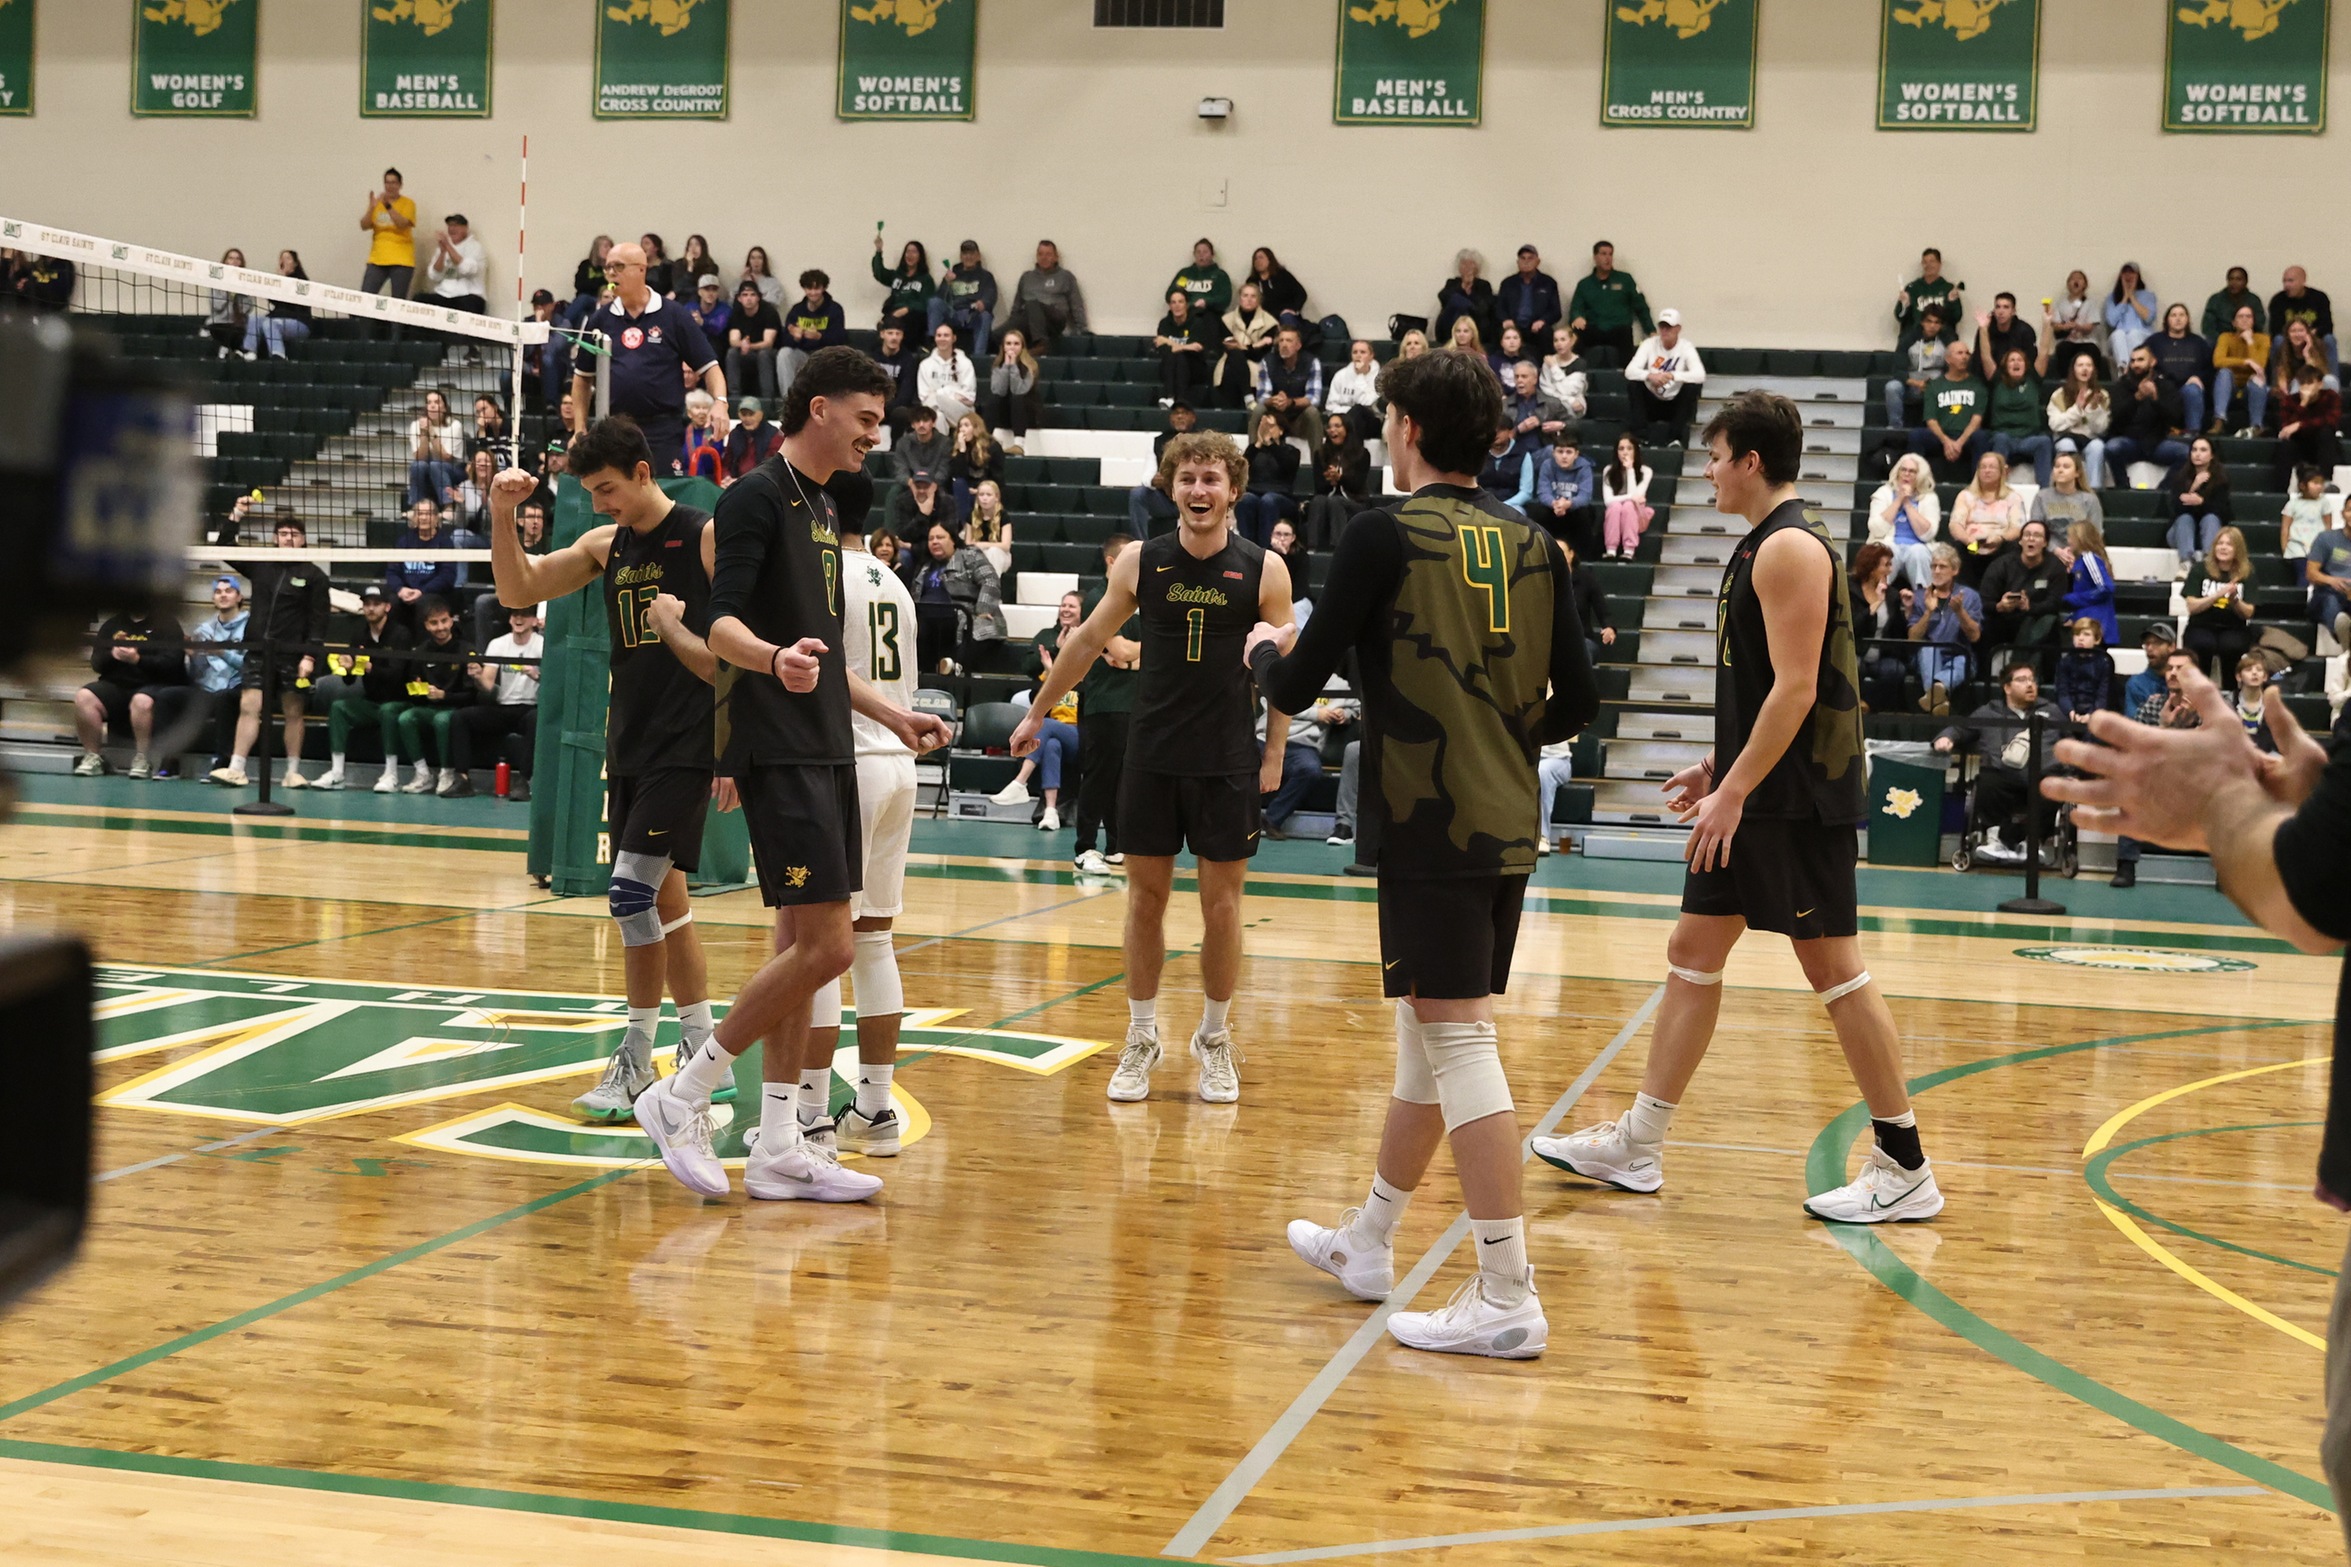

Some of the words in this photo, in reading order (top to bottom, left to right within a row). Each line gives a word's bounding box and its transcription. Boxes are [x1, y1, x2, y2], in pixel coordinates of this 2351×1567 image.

[151, 74, 244, 91] WOMEN'S
[396, 75, 459, 91] MEN'S
[601, 84, 660, 96] ANDREW
[858, 76, 962, 94] WOMEN'S
[1375, 79, 1447, 97] MEN'S
[172, 92, 223, 108] GOLF
[376, 93, 479, 109] BASEBALL
[1650, 90, 1705, 104] MEN'S
[1901, 82, 2018, 102] WOMEN'S
[2186, 84, 2307, 103] WOMEN'S
[600, 98, 650, 112] CROSS
[652, 99, 723, 112] COUNTRY
[854, 95, 964, 112] SOFTBALL
[1351, 98, 1469, 116] BASEBALL
[1608, 104, 1663, 119] CROSS
[1666, 105, 1748, 120] COUNTRY
[1896, 102, 2021, 121] SOFTBALL
[2181, 104, 2310, 123] SOFTBALL
[1937, 389, 1976, 409] SAINTS
[614, 562, 664, 586] Saints
[1457, 524, 1511, 634] 4
[1165, 582, 1228, 606] Saints
[617, 584, 661, 649] 12
[868, 601, 902, 682] 13
[1186, 607, 1205, 662] 1
